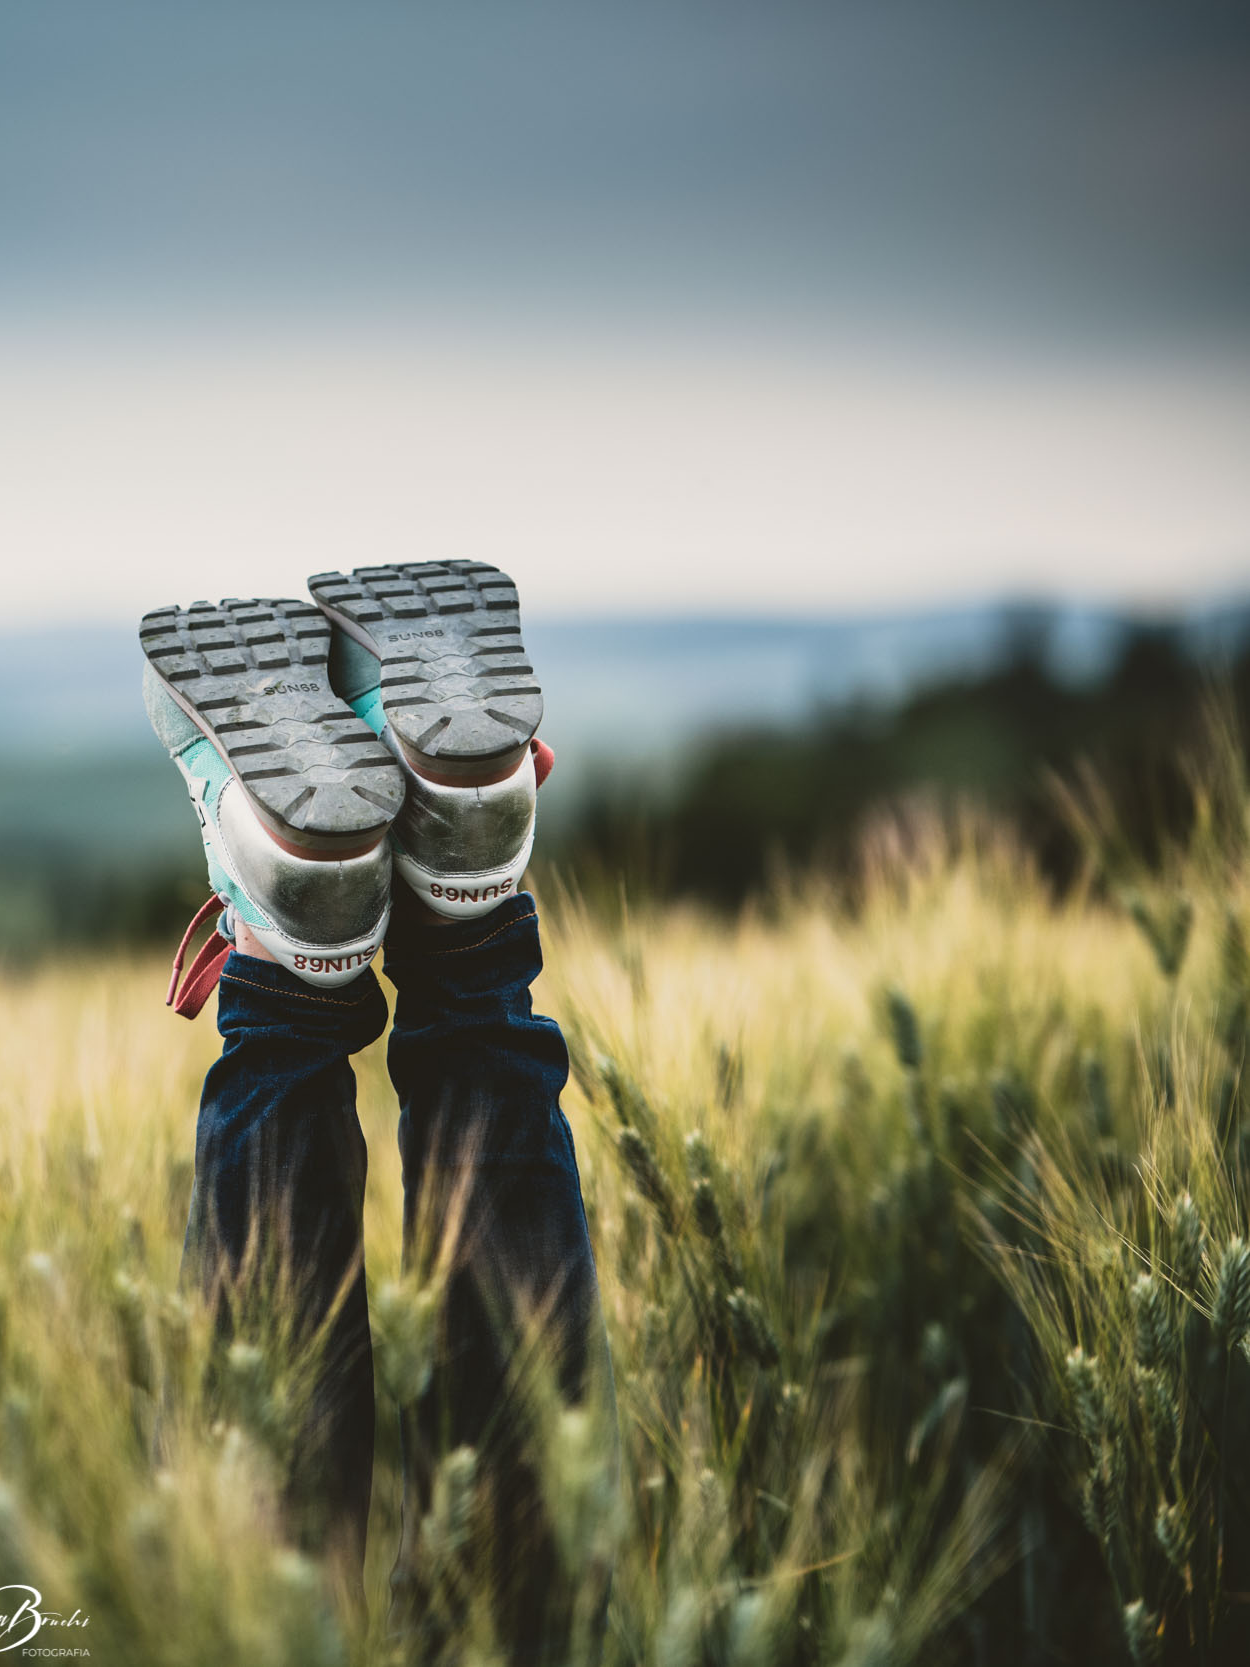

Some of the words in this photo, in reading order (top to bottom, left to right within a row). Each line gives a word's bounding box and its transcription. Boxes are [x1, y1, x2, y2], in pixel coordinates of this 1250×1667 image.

[388, 629, 445, 643] SUN68
[263, 683, 320, 696] SUN68
[429, 877, 514, 903] SUN68
[293, 945, 376, 974] SUN68
